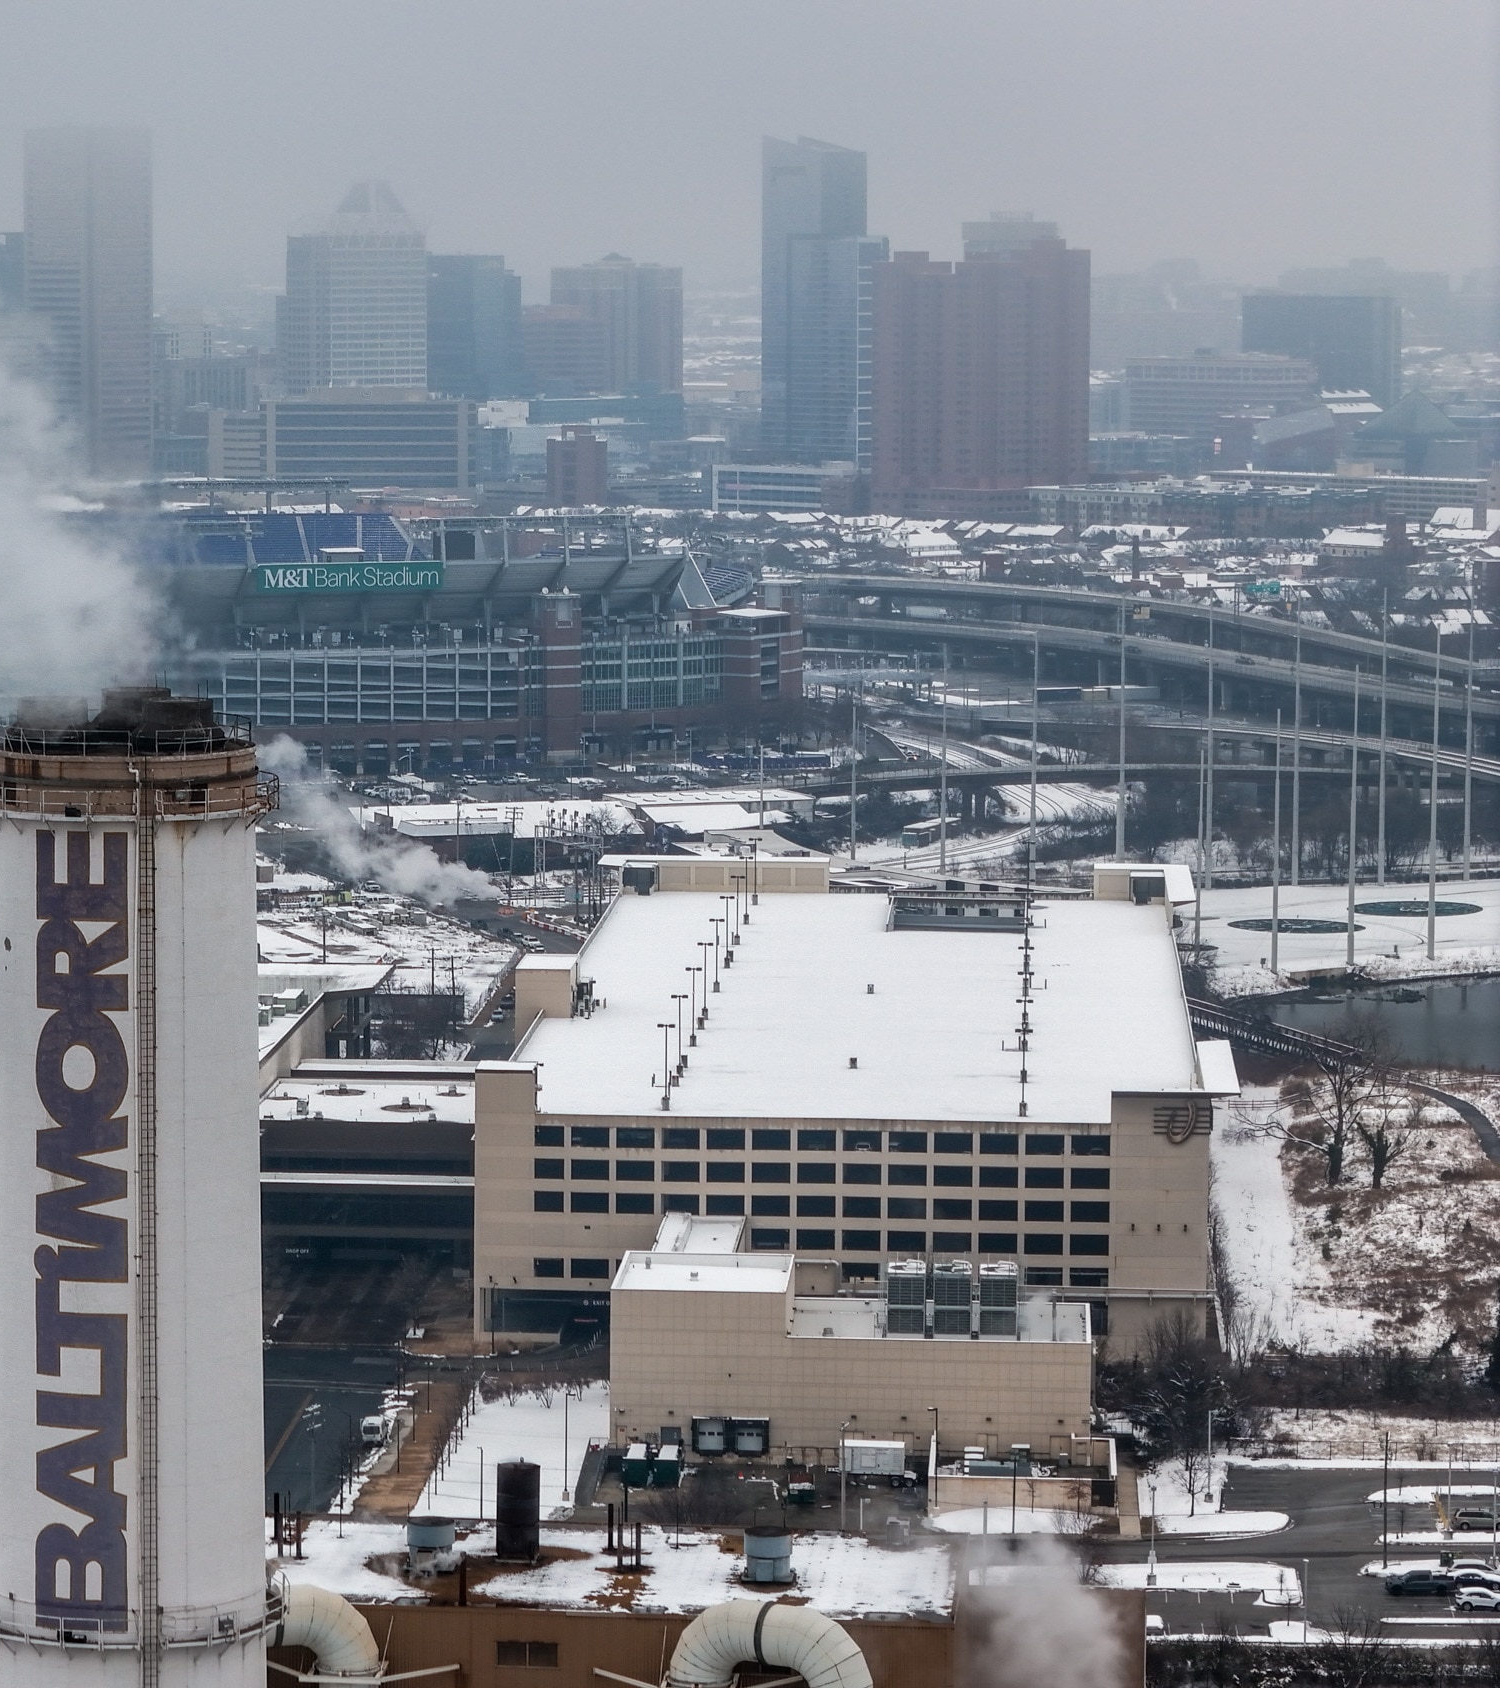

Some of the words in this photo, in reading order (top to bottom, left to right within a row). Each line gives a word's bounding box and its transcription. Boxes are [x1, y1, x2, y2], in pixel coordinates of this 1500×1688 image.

[264, 568, 312, 589] M&T
[314, 567, 360, 587] Bank
[363, 566, 439, 586] Stadium
